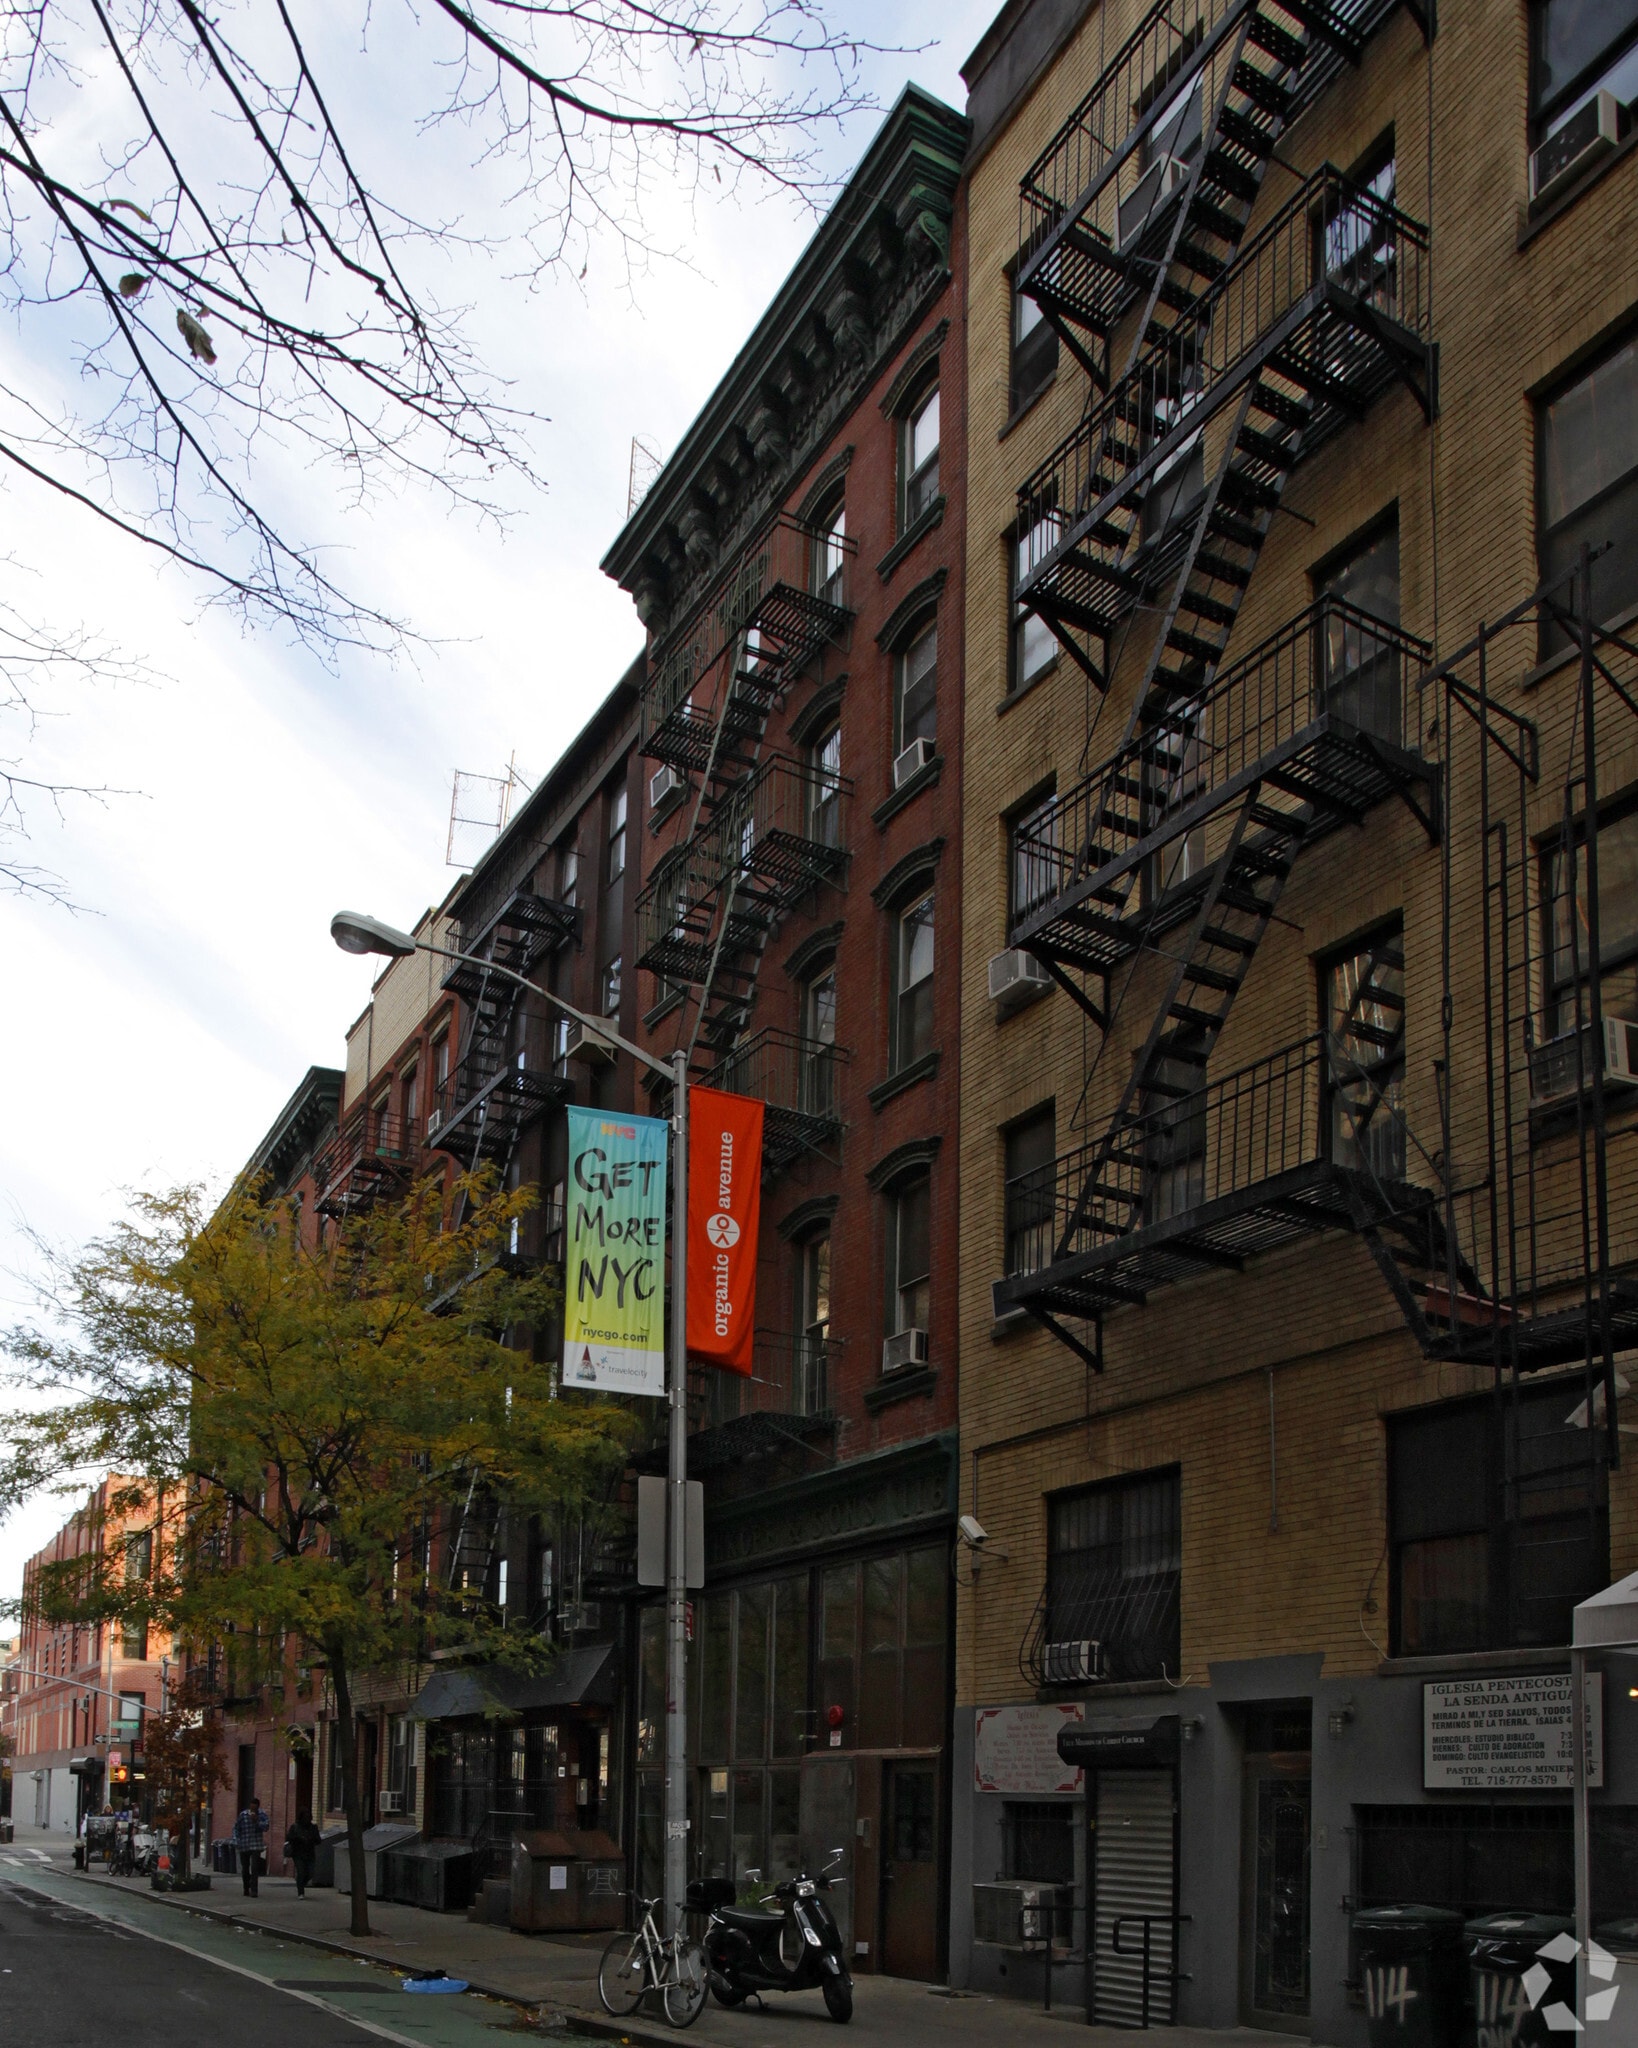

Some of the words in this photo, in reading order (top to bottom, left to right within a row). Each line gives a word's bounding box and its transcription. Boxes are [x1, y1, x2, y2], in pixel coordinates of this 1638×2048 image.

[601, 1122, 636, 1140] NYC
[718, 1131, 733, 1210] avenue
[577, 1254, 656, 1309] NYC
[712, 1253, 732, 1337] organic
[583, 1328, 648, 1343] nycgo.com
[609, 1366, 648, 1379] travelocity
[1431, 1681, 1484, 1695] IGLESIA
[1488, 1675, 1591, 1691] PENTECOST
[1444, 1697, 1460, 1707] LA
[1463, 1693, 1509, 1706] SENDA
[1433, 1711, 1458, 1720] MIRAD
[1461, 1711, 1467, 1719] A
[1488, 1709, 1504, 1718] SED
[1506, 1707, 1540, 1717] SALVOS,
[1543, 1706, 1572, 1715] TODOS
[1431, 1720, 1471, 1730] TERMINOS
[1474, 1719, 1484, 1728] DE
[1486, 1719, 1496, 1728] LA
[1499, 1717, 1530, 1727] TIERRA.
[1536, 1716, 1563, 1725] ISAIAS
[1432, 1735, 1473, 1744] MIERCOLES:
[1475, 1733, 1504, 1743] ESTUDIO
[1506, 1732, 1535, 1742] BIBLICO
[1432, 1743, 1463, 1753] VIERNES:
[1468, 1742, 1490, 1751] CULTO
[1492, 1742, 1501, 1751] DE
[1503, 1740, 1545, 1750] ADORACION
[1432, 1752, 1467, 1762] DOMINGO:
[1468, 1751, 1489, 1760] CULTO
[1491, 1750, 1546, 1760] EVANGELISTICO
[1446, 1766, 1488, 1775] PASTOR:
[1490, 1765, 1533, 1774] CARLOS
[1461, 1776, 1484, 1786] TEL.
[1487, 1775, 1558, 1785] 718-777-8579
[1366, 1966, 1417, 2023] 114
